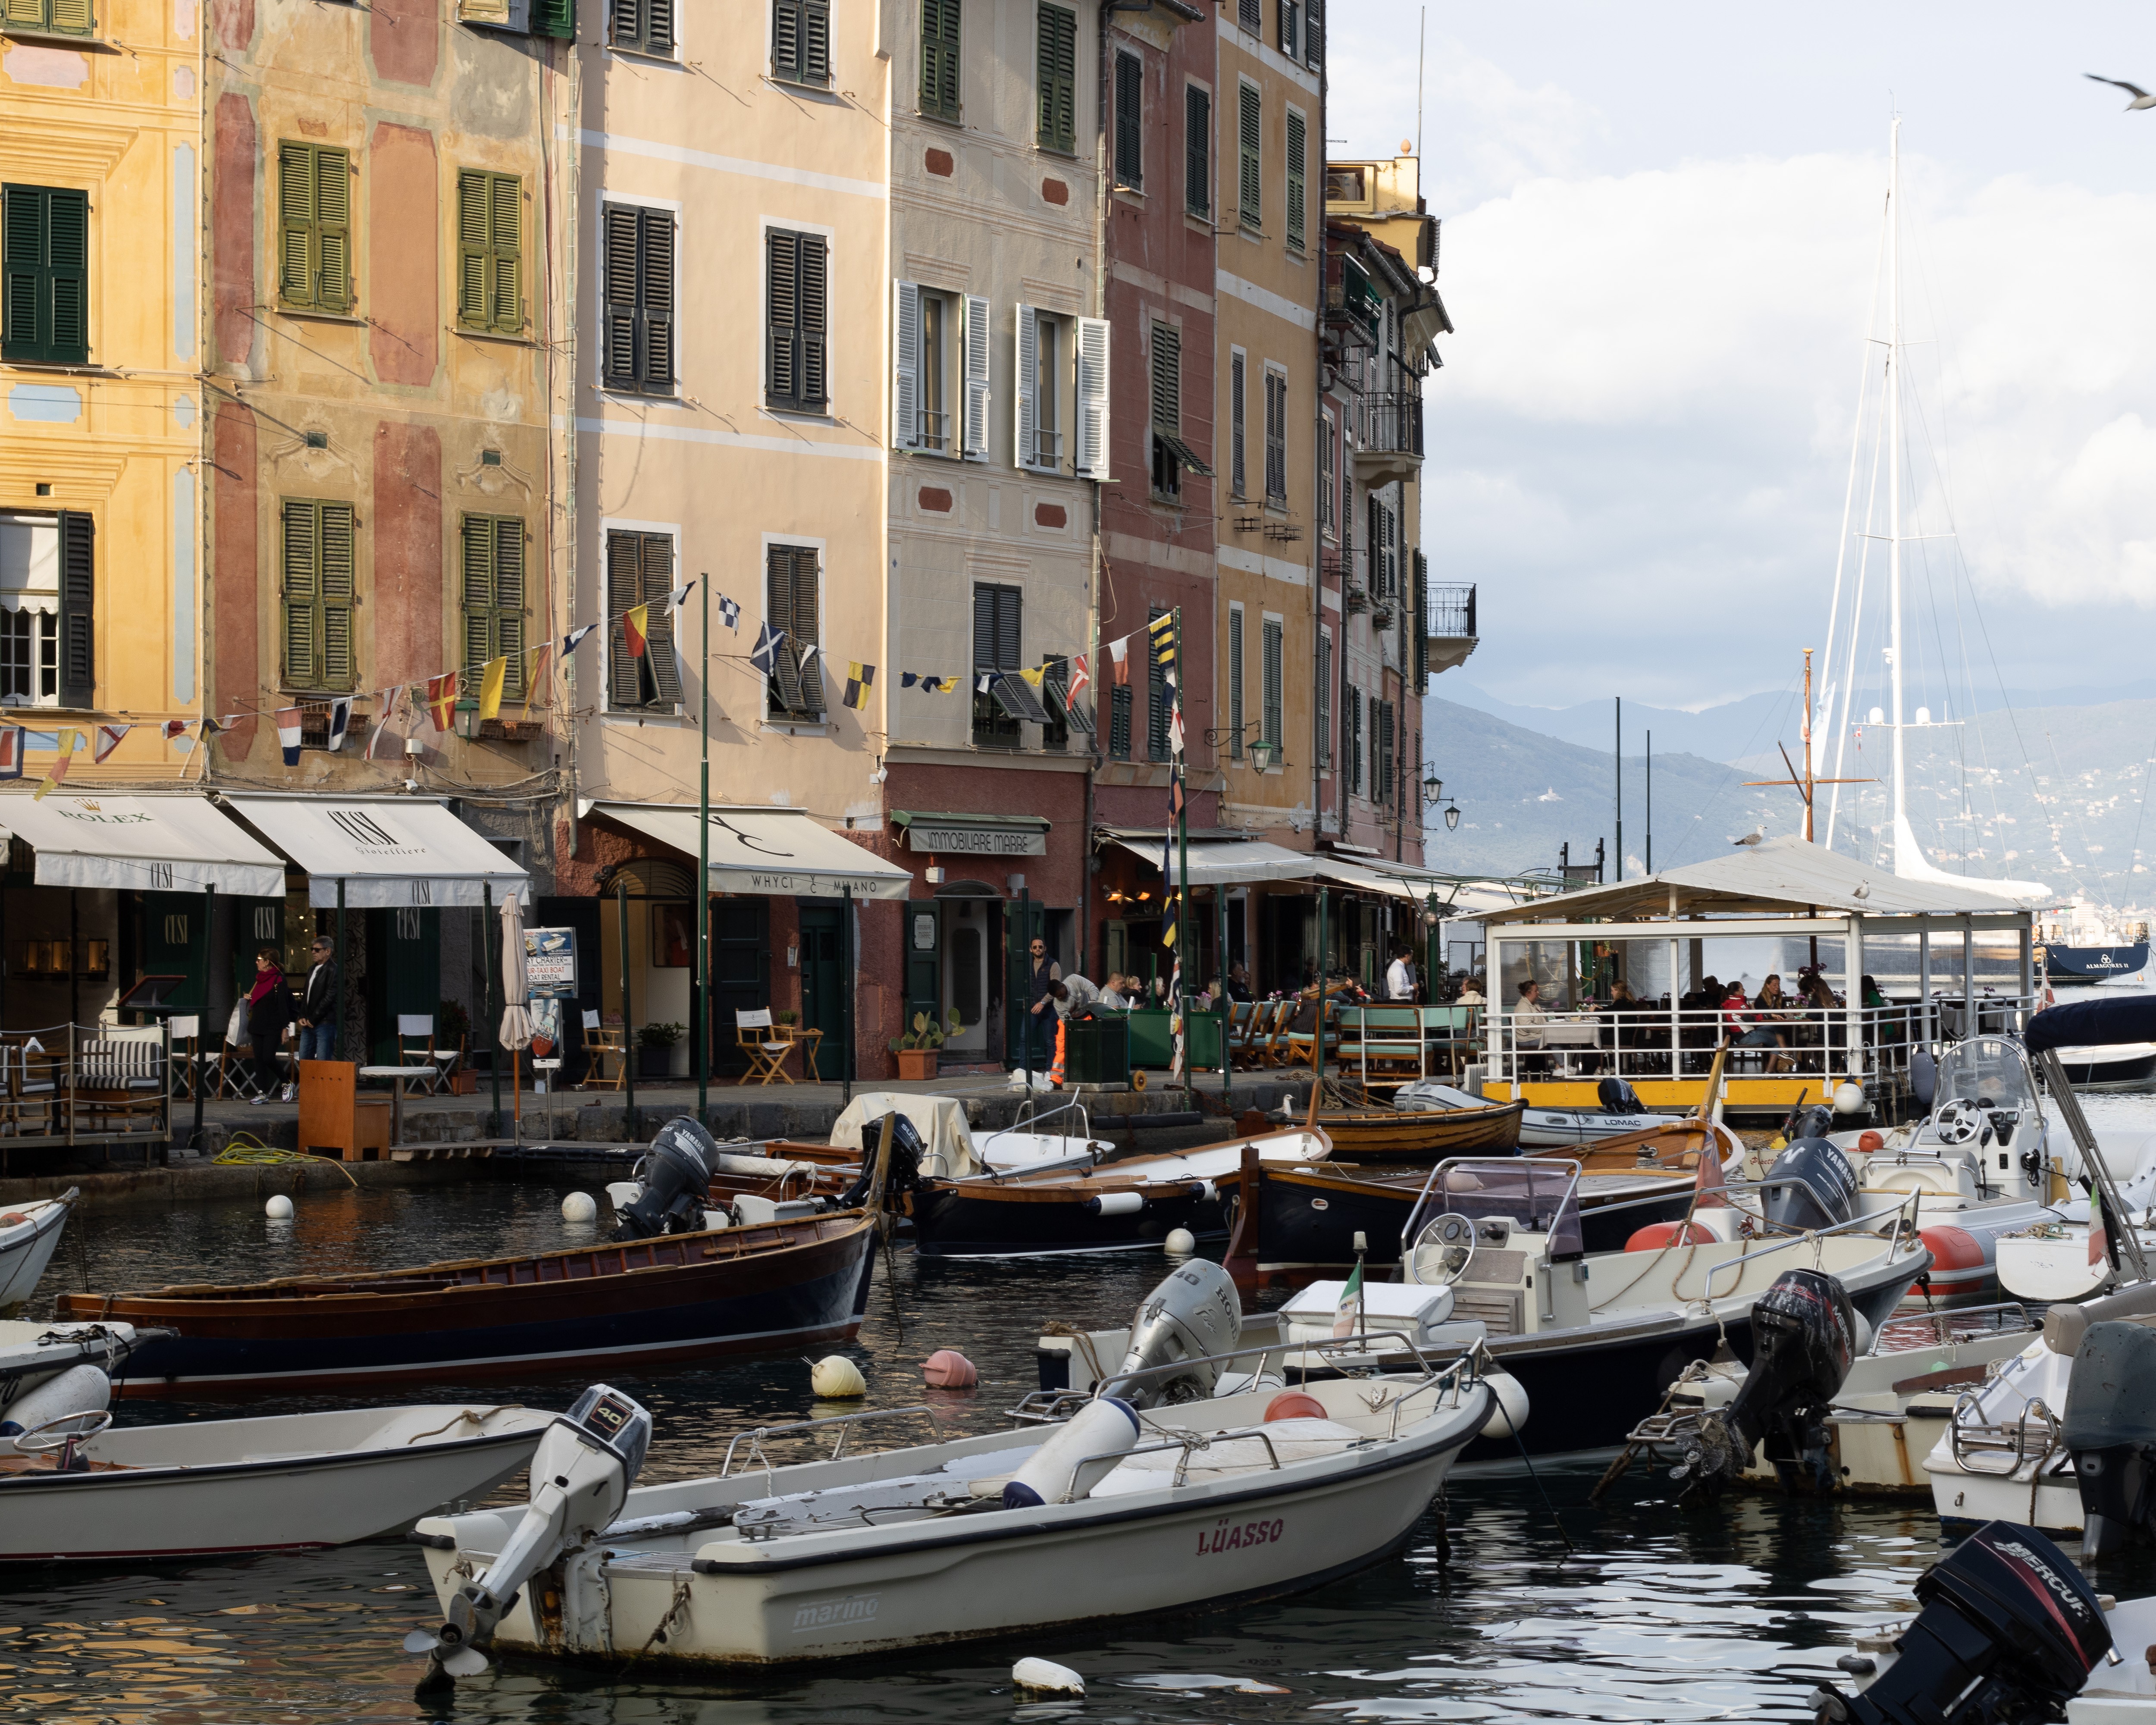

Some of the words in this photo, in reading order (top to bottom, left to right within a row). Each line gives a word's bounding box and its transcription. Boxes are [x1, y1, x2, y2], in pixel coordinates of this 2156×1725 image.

[55, 809, 155, 823] ROLEX
[327, 810, 401, 846] CUSI
[355, 847, 427, 855] Gioielliere
[928, 831, 992, 851] IMMOBILIARE
[151, 862, 173, 889] CUSI
[752, 875, 793, 889] WHYCI
[412, 880, 431, 905] CUSI
[165, 914, 188, 944] CUSI
[255, 906, 276, 939] CUSI
[397, 907, 420, 939] CUSI
[536, 955, 564, 964] CHARTER
[682, 1128, 705, 1154] YAMAHA
[1827, 1147, 1855, 1191] YAMAHA
[1173, 1270, 1201, 1286] 40
[1215, 1285, 1238, 1341] HOND
[597, 1407, 623, 1425] 40
[1195, 1518, 1284, 1556] LÜASSO
[1992, 1540, 2090, 1621] MERCUR
[793, 1598, 880, 1627] marino
